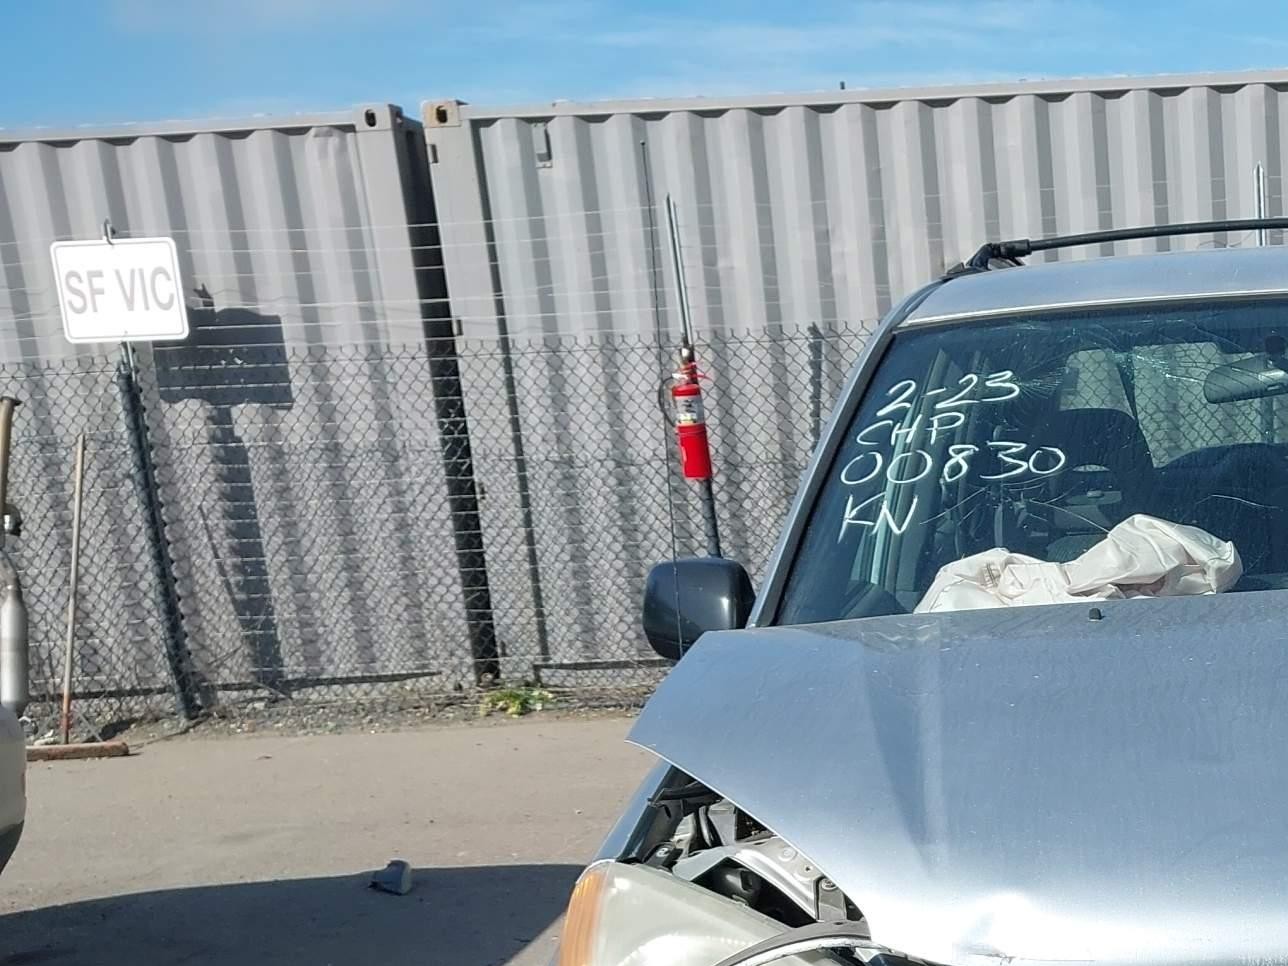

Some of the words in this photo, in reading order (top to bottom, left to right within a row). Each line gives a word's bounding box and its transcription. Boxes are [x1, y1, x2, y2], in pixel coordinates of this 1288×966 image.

[65, 269, 105, 315] SF
[115, 265, 175, 312] VIC
[876, 370, 1021, 417] 2-23
[856, 411, 965, 446] CHP
[840, 440, 1066, 485] 00830
